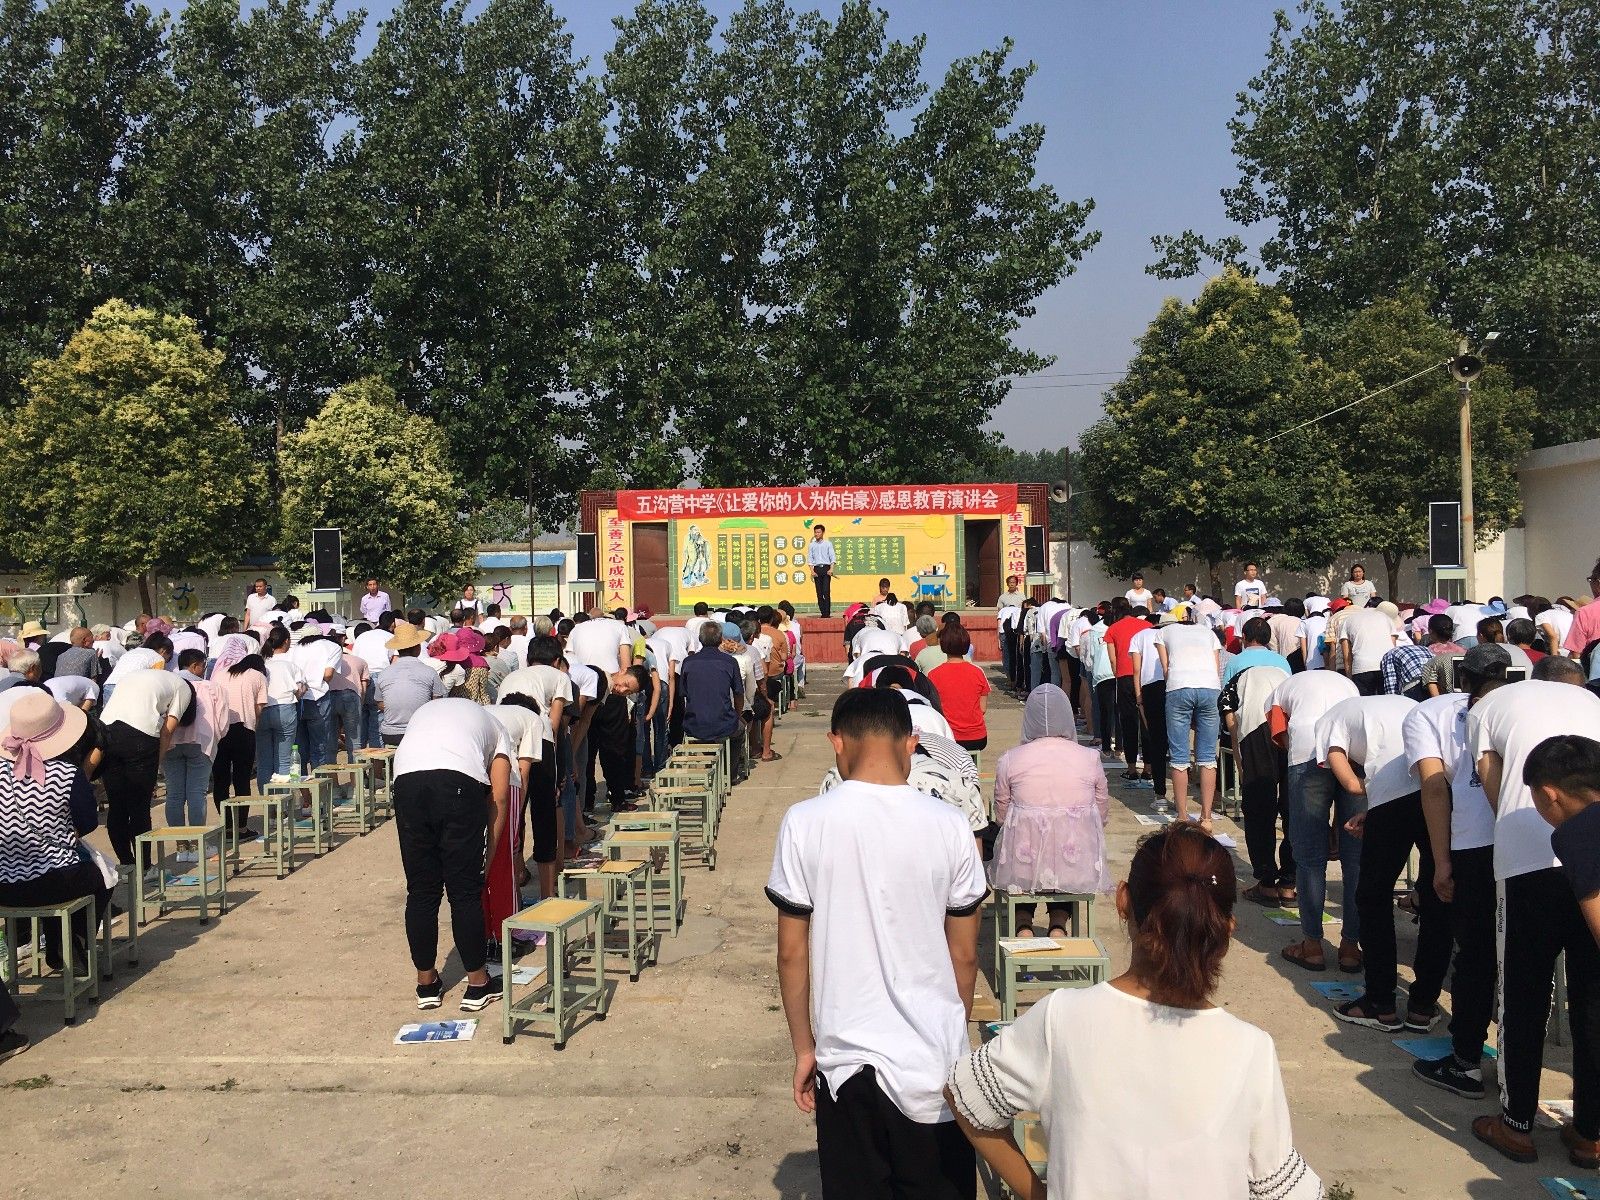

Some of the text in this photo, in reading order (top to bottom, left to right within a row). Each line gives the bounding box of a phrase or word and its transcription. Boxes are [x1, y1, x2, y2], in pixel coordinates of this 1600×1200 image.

[636, 487, 999, 515] 五沟营中学《让爱你的人为你自豪》感恩教育演讲会
[607, 517, 625, 602] 至善之心成就人
